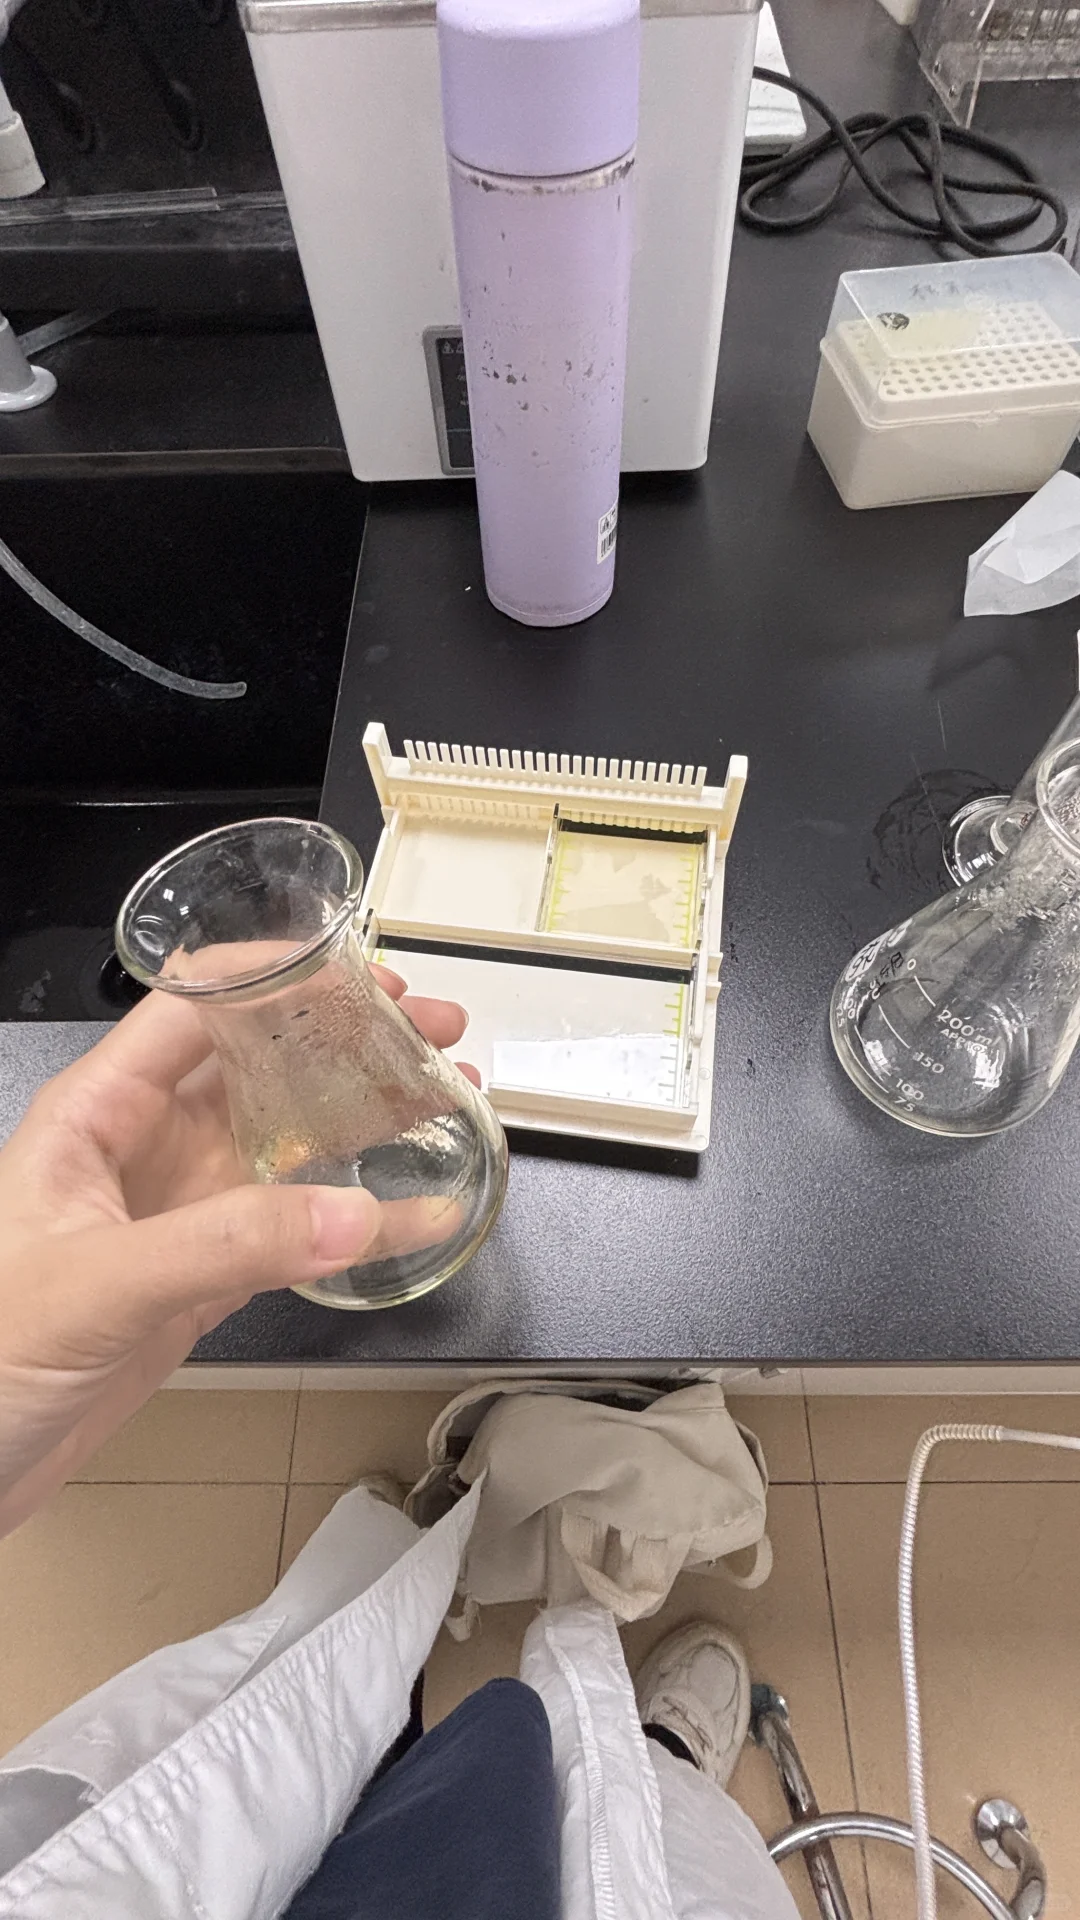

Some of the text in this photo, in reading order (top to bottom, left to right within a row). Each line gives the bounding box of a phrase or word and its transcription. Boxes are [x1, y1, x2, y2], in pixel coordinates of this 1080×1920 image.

[915, 1051, 945, 1074] 150
[895, 1078, 925, 1101] 100
[894, 1096, 916, 1112] 75
